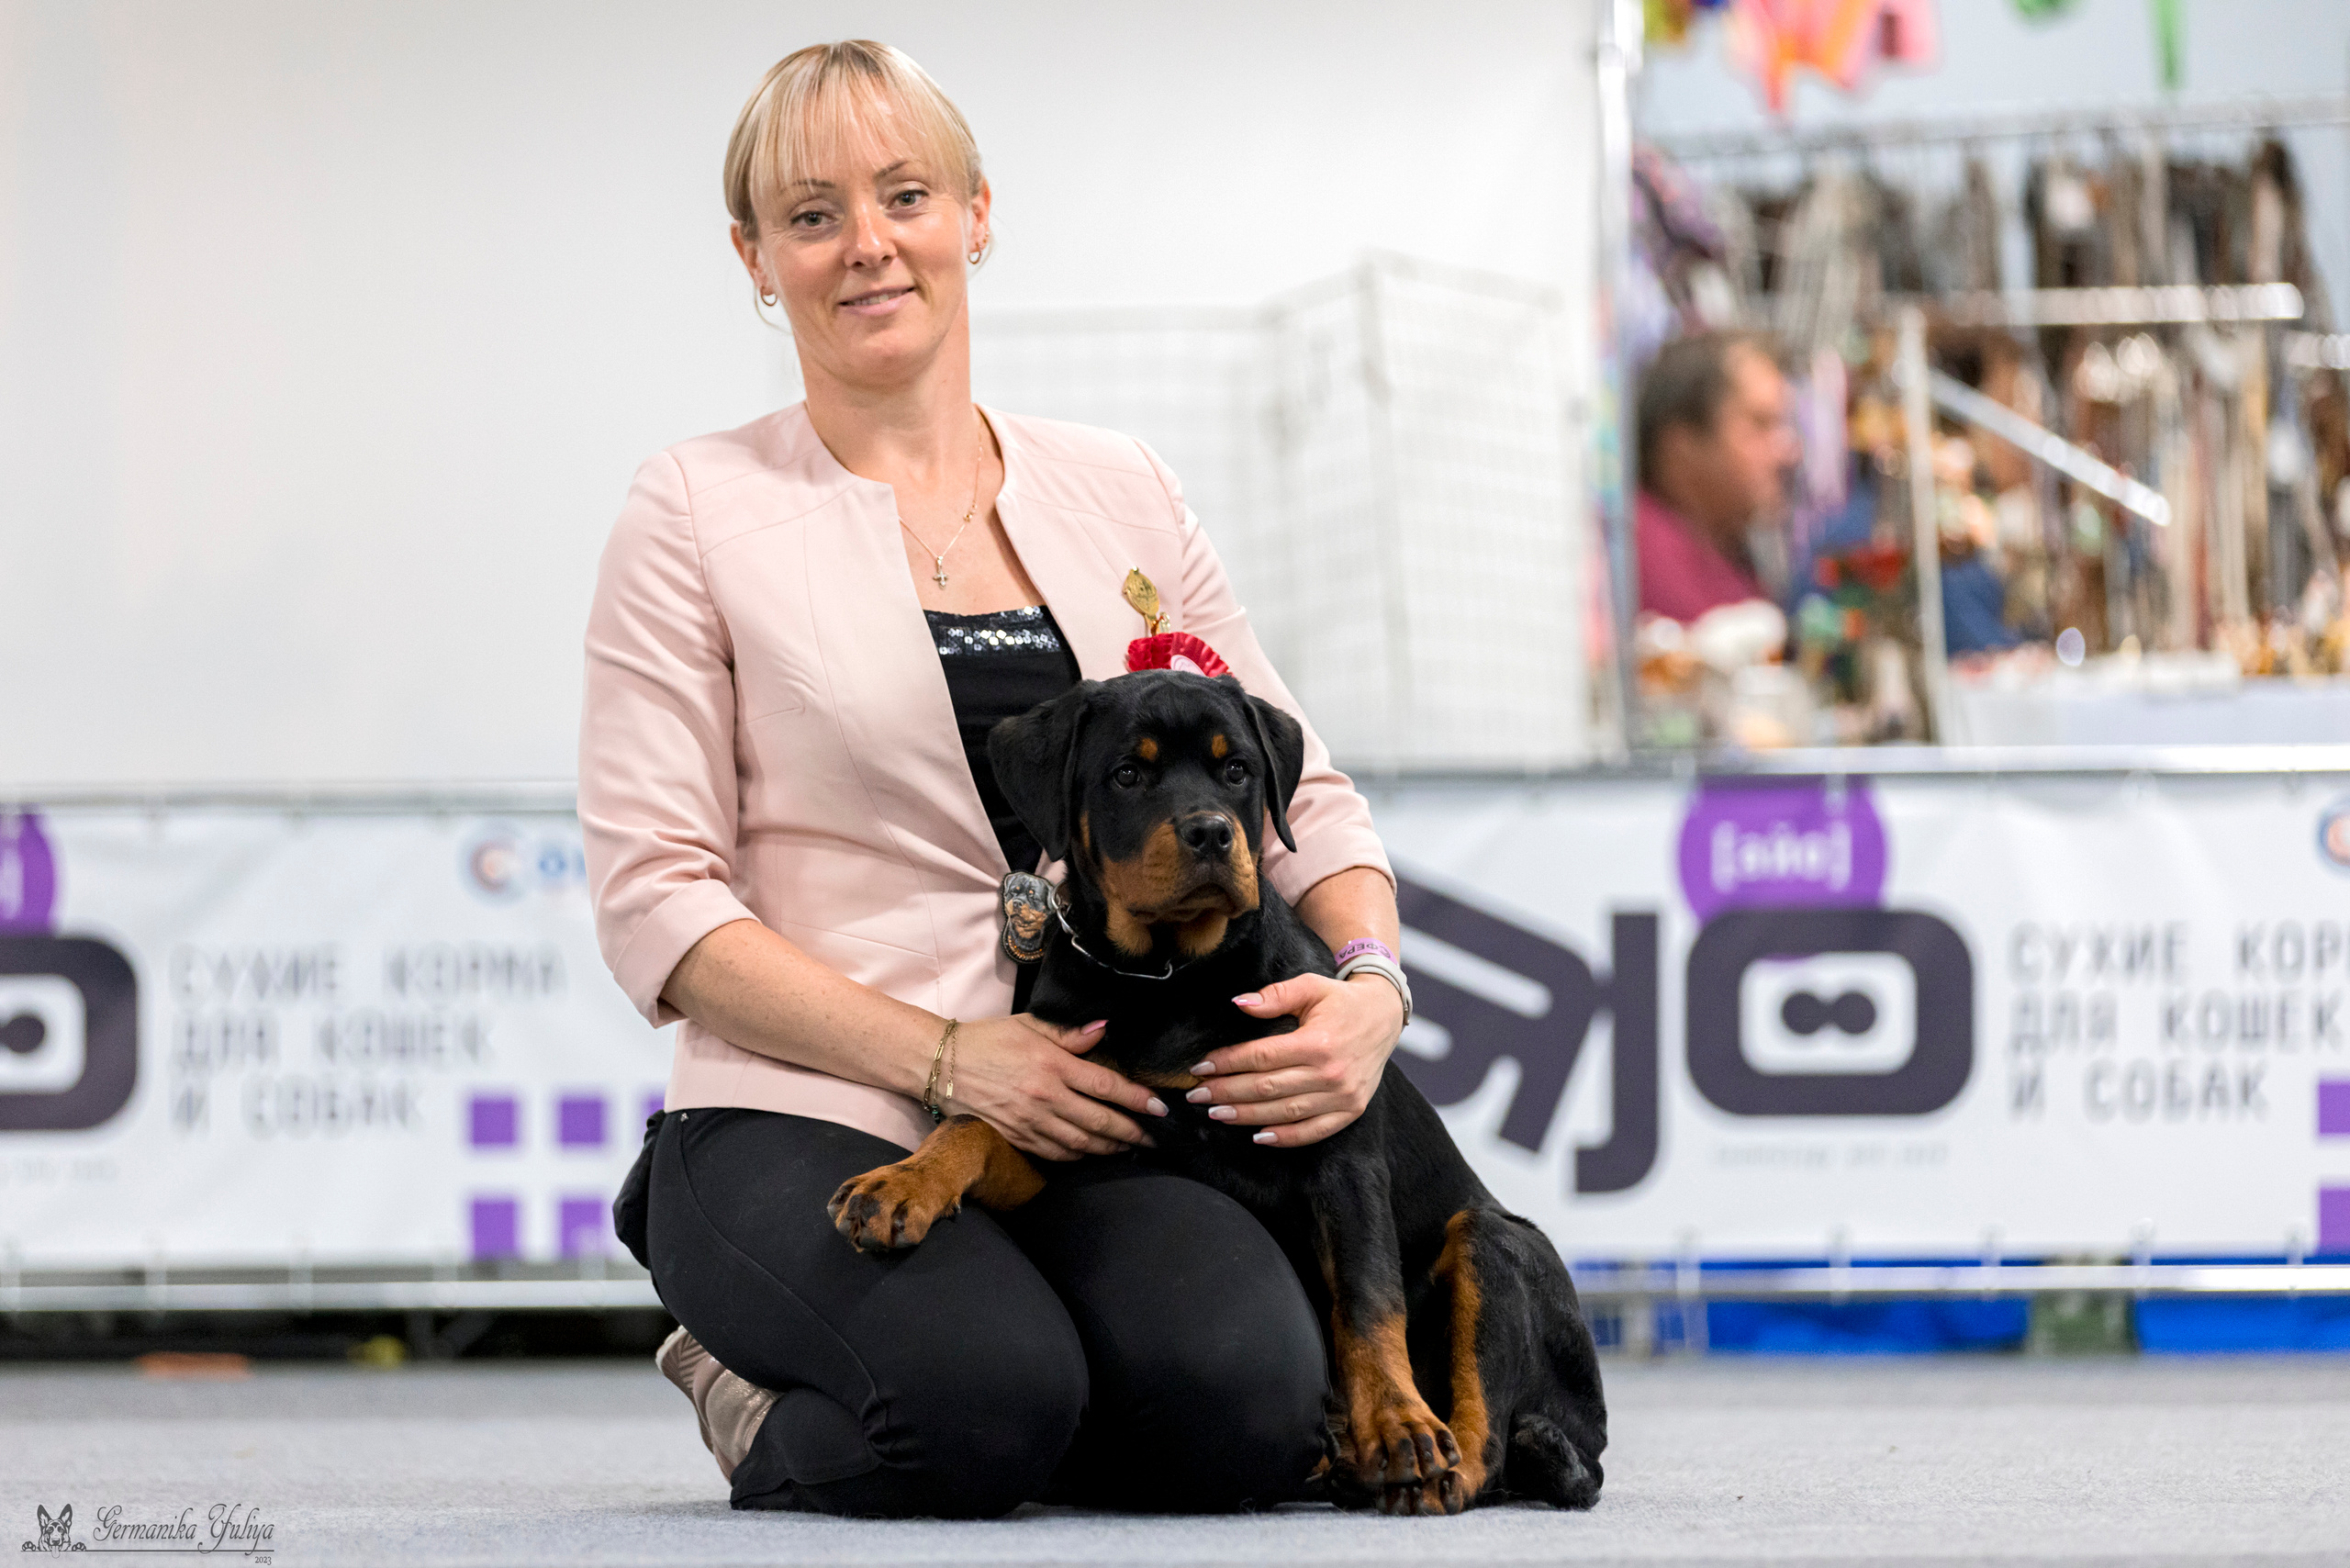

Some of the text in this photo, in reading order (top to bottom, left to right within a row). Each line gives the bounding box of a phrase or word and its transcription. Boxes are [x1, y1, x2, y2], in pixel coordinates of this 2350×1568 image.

[1339, 943, 1391, 958] СФЕРА
[2009, 920, 2350, 983] СУХИЕ КОР
[2009, 989, 2343, 1054] ДЛЯ КОШЕК
[2009, 1059, 2268, 1123] И СОБАК
